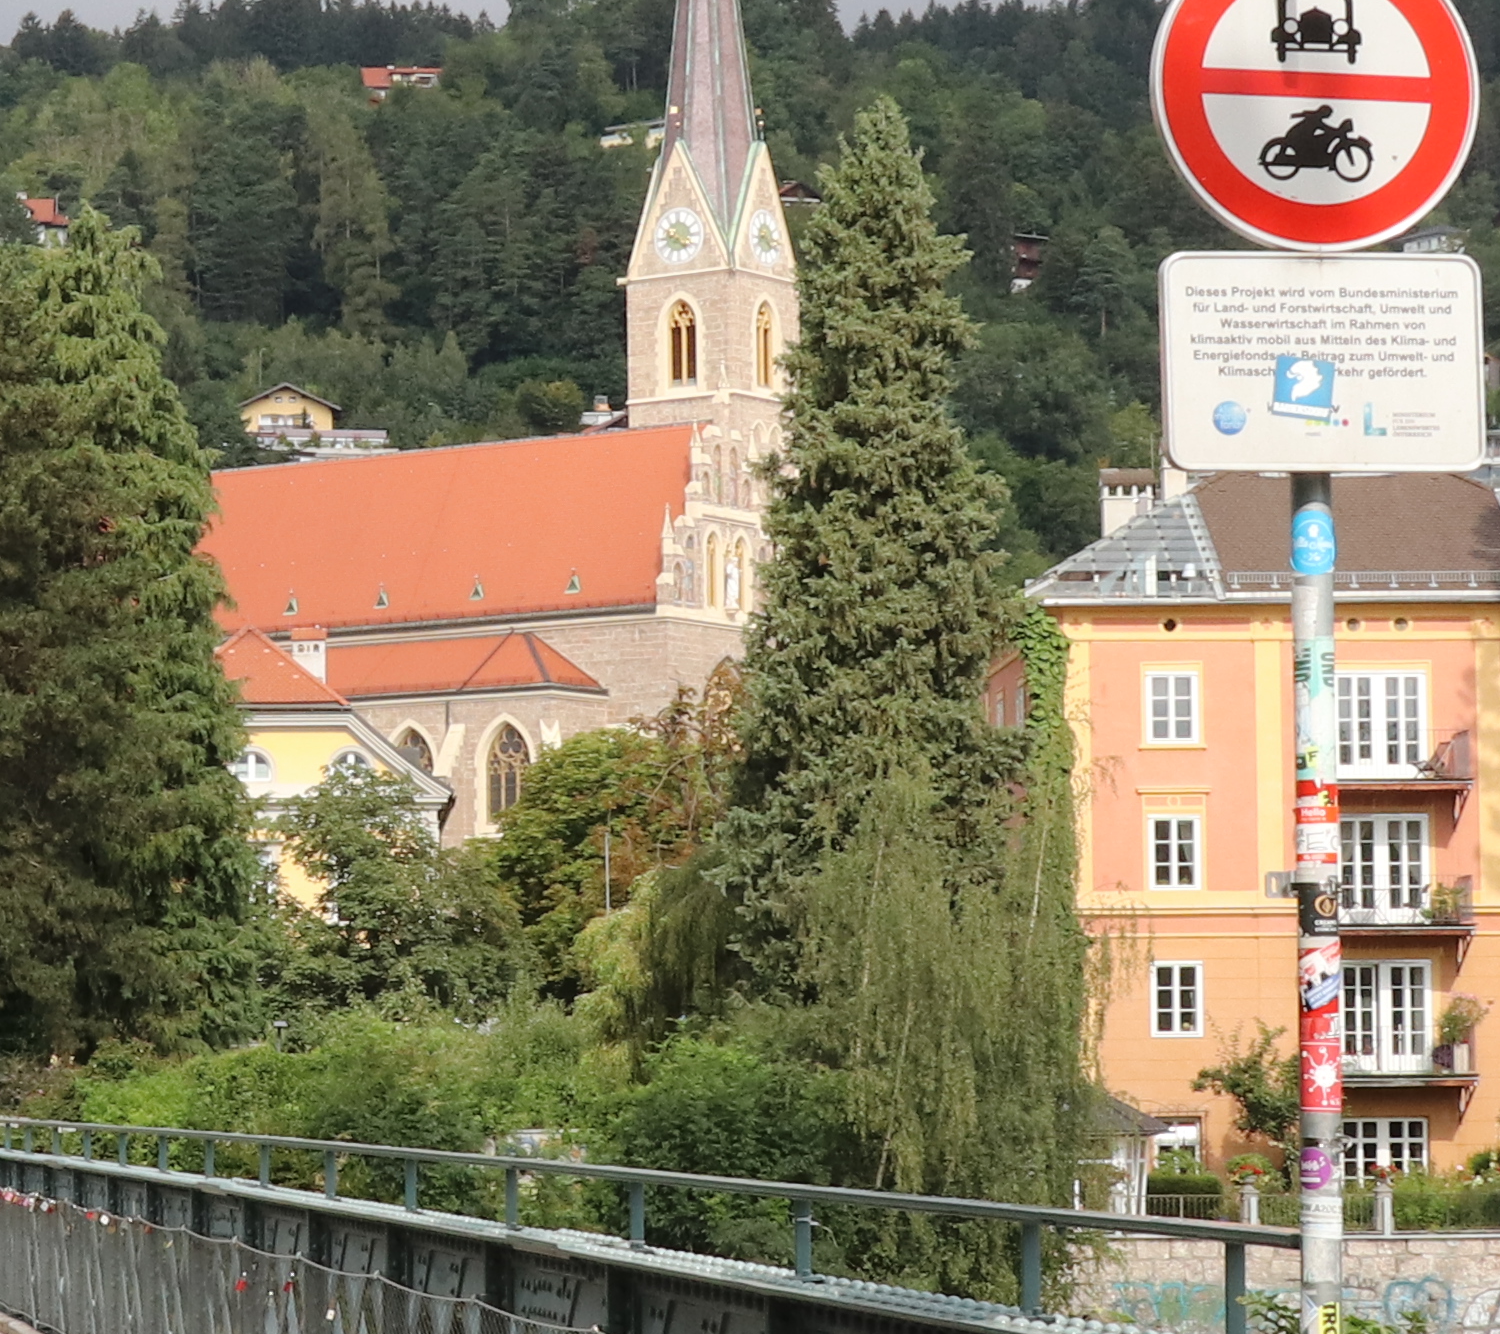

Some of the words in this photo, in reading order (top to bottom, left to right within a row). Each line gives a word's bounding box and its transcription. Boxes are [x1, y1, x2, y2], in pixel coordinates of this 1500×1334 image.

[1185, 286, 1228, 298] Dieses
[1231, 286, 1275, 301] Projekt
[1278, 287, 1305, 298] wird
[1308, 289, 1335, 298] vom
[1339, 287, 1458, 299] Bundesministerium
[1192, 302, 1210, 313] für
[1214, 302, 1249, 313] Land-
[1252, 303, 1276, 314] und
[1280, 302, 1376, 316] Forstwirtschaft,
[1380, 304, 1425, 314] Umwelt
[1429, 304, 1452, 315] und
[1220, 318, 1327, 330] Wasserwirtschaft
[1331, 319, 1346, 330] im
[1349, 319, 1400, 330] Rahmen
[1403, 322, 1426, 330] von
[1190, 334, 1253, 345] klimaaktiv
[1256, 334, 1291, 345] mobil
[1294, 337, 1317, 346] aus
[1320, 334, 1362, 346] Mitteln
[1365, 335, 1387, 346] des
[1391, 335, 1430, 346] Klima-
[1433, 336, 1457, 346] und
[1193, 350, 1275, 363] Energiefonds
[1301, 350, 1345, 364] Beitrag
[1348, 353, 1375, 361] zum
[1378, 351, 1428, 362] Umwelt-
[1431, 352, 1455, 362] und
[1218, 366, 1275, 377] Klimasch
[1368, 366, 1427, 380] gefördert.
